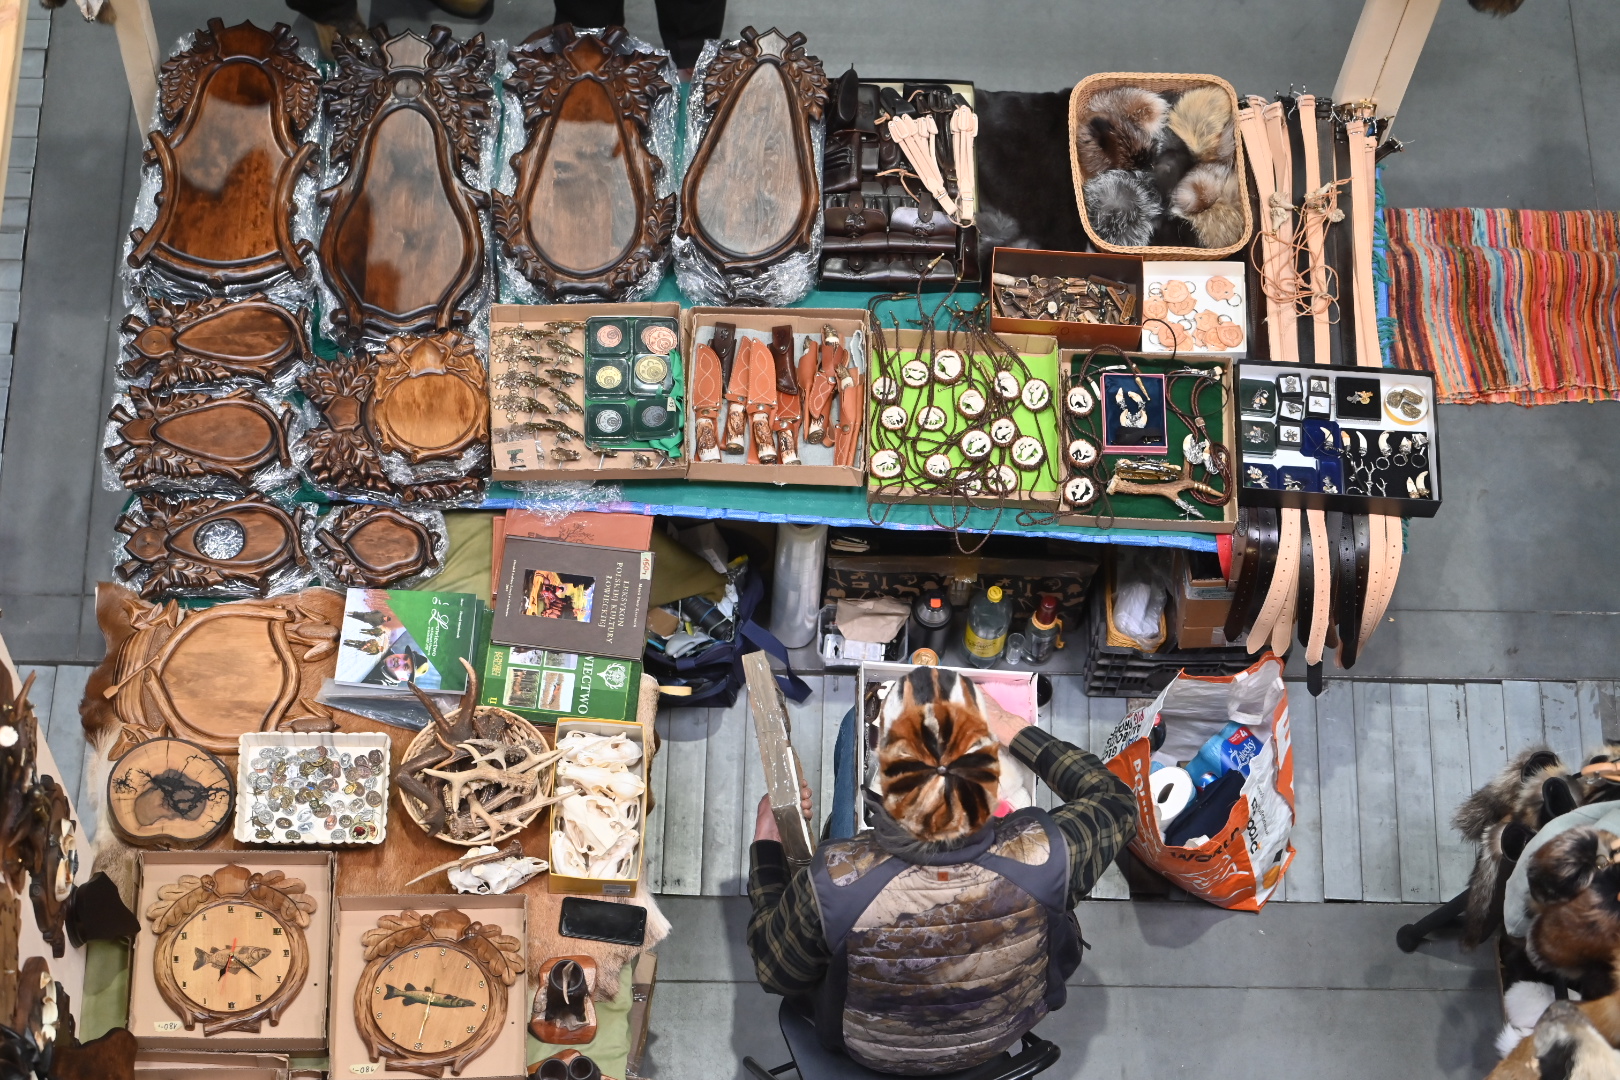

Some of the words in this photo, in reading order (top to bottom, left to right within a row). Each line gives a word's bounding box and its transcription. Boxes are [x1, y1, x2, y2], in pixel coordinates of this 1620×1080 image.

[611, 562, 624, 602] POLSKIEJ
[606, 604, 618, 644] KULTURY
[618, 581, 630, 627] LEKSYKON
